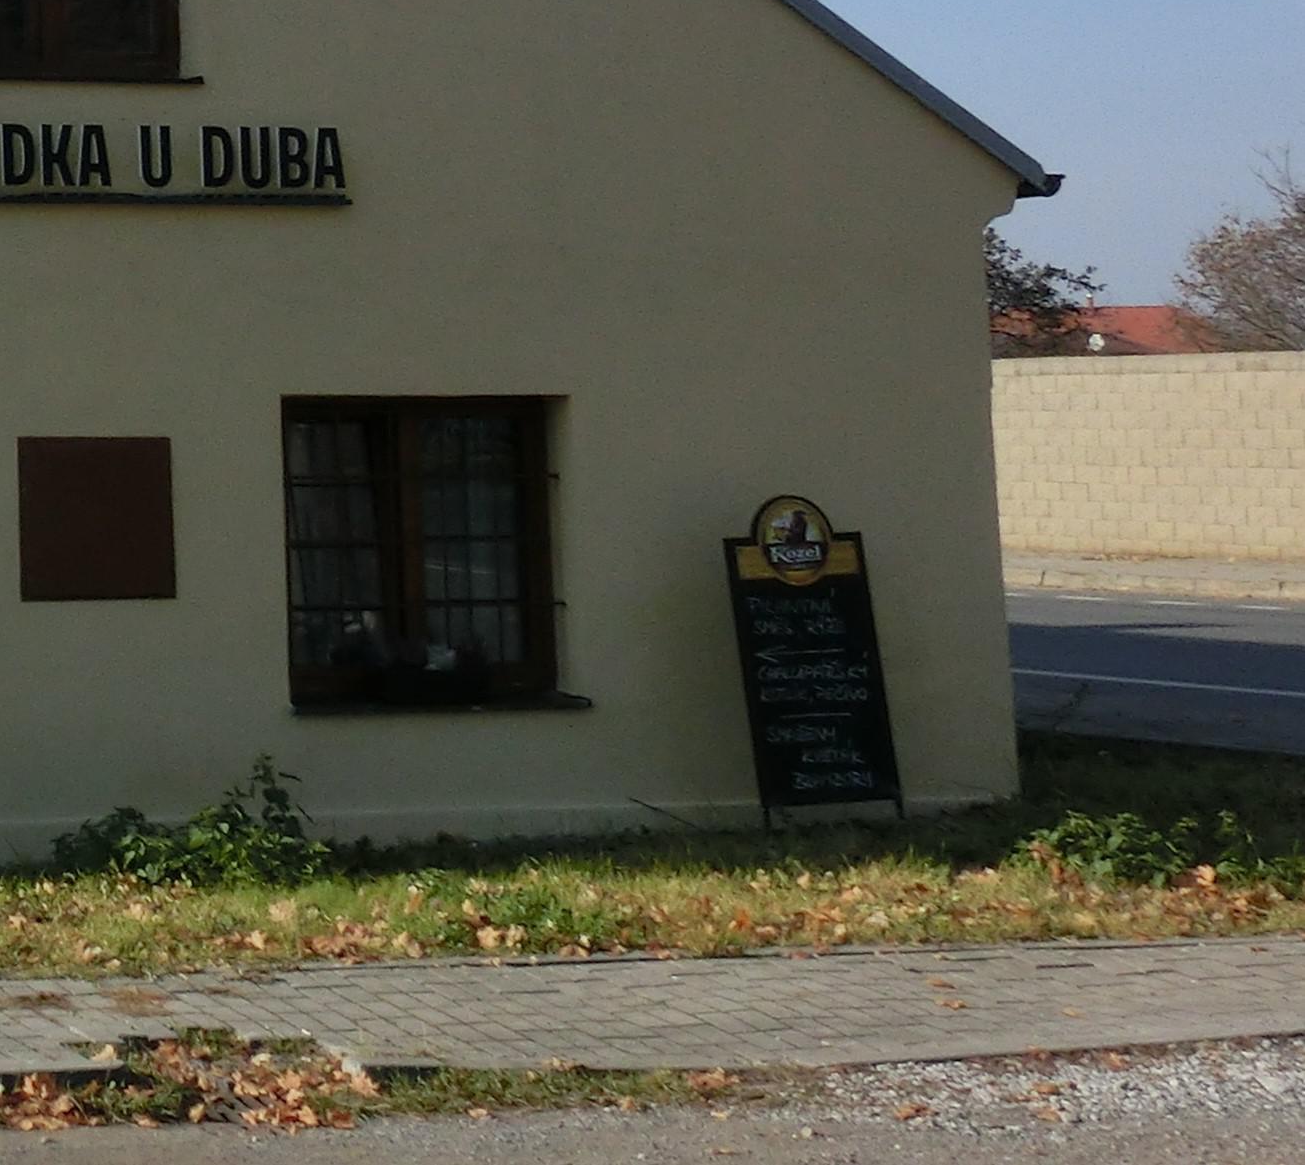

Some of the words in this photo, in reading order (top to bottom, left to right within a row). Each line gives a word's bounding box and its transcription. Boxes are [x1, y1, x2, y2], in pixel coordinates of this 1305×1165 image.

[139, 125, 172, 187] U
[201, 126, 347, 189] DUBA
[769, 544, 822, 563] Kozel
